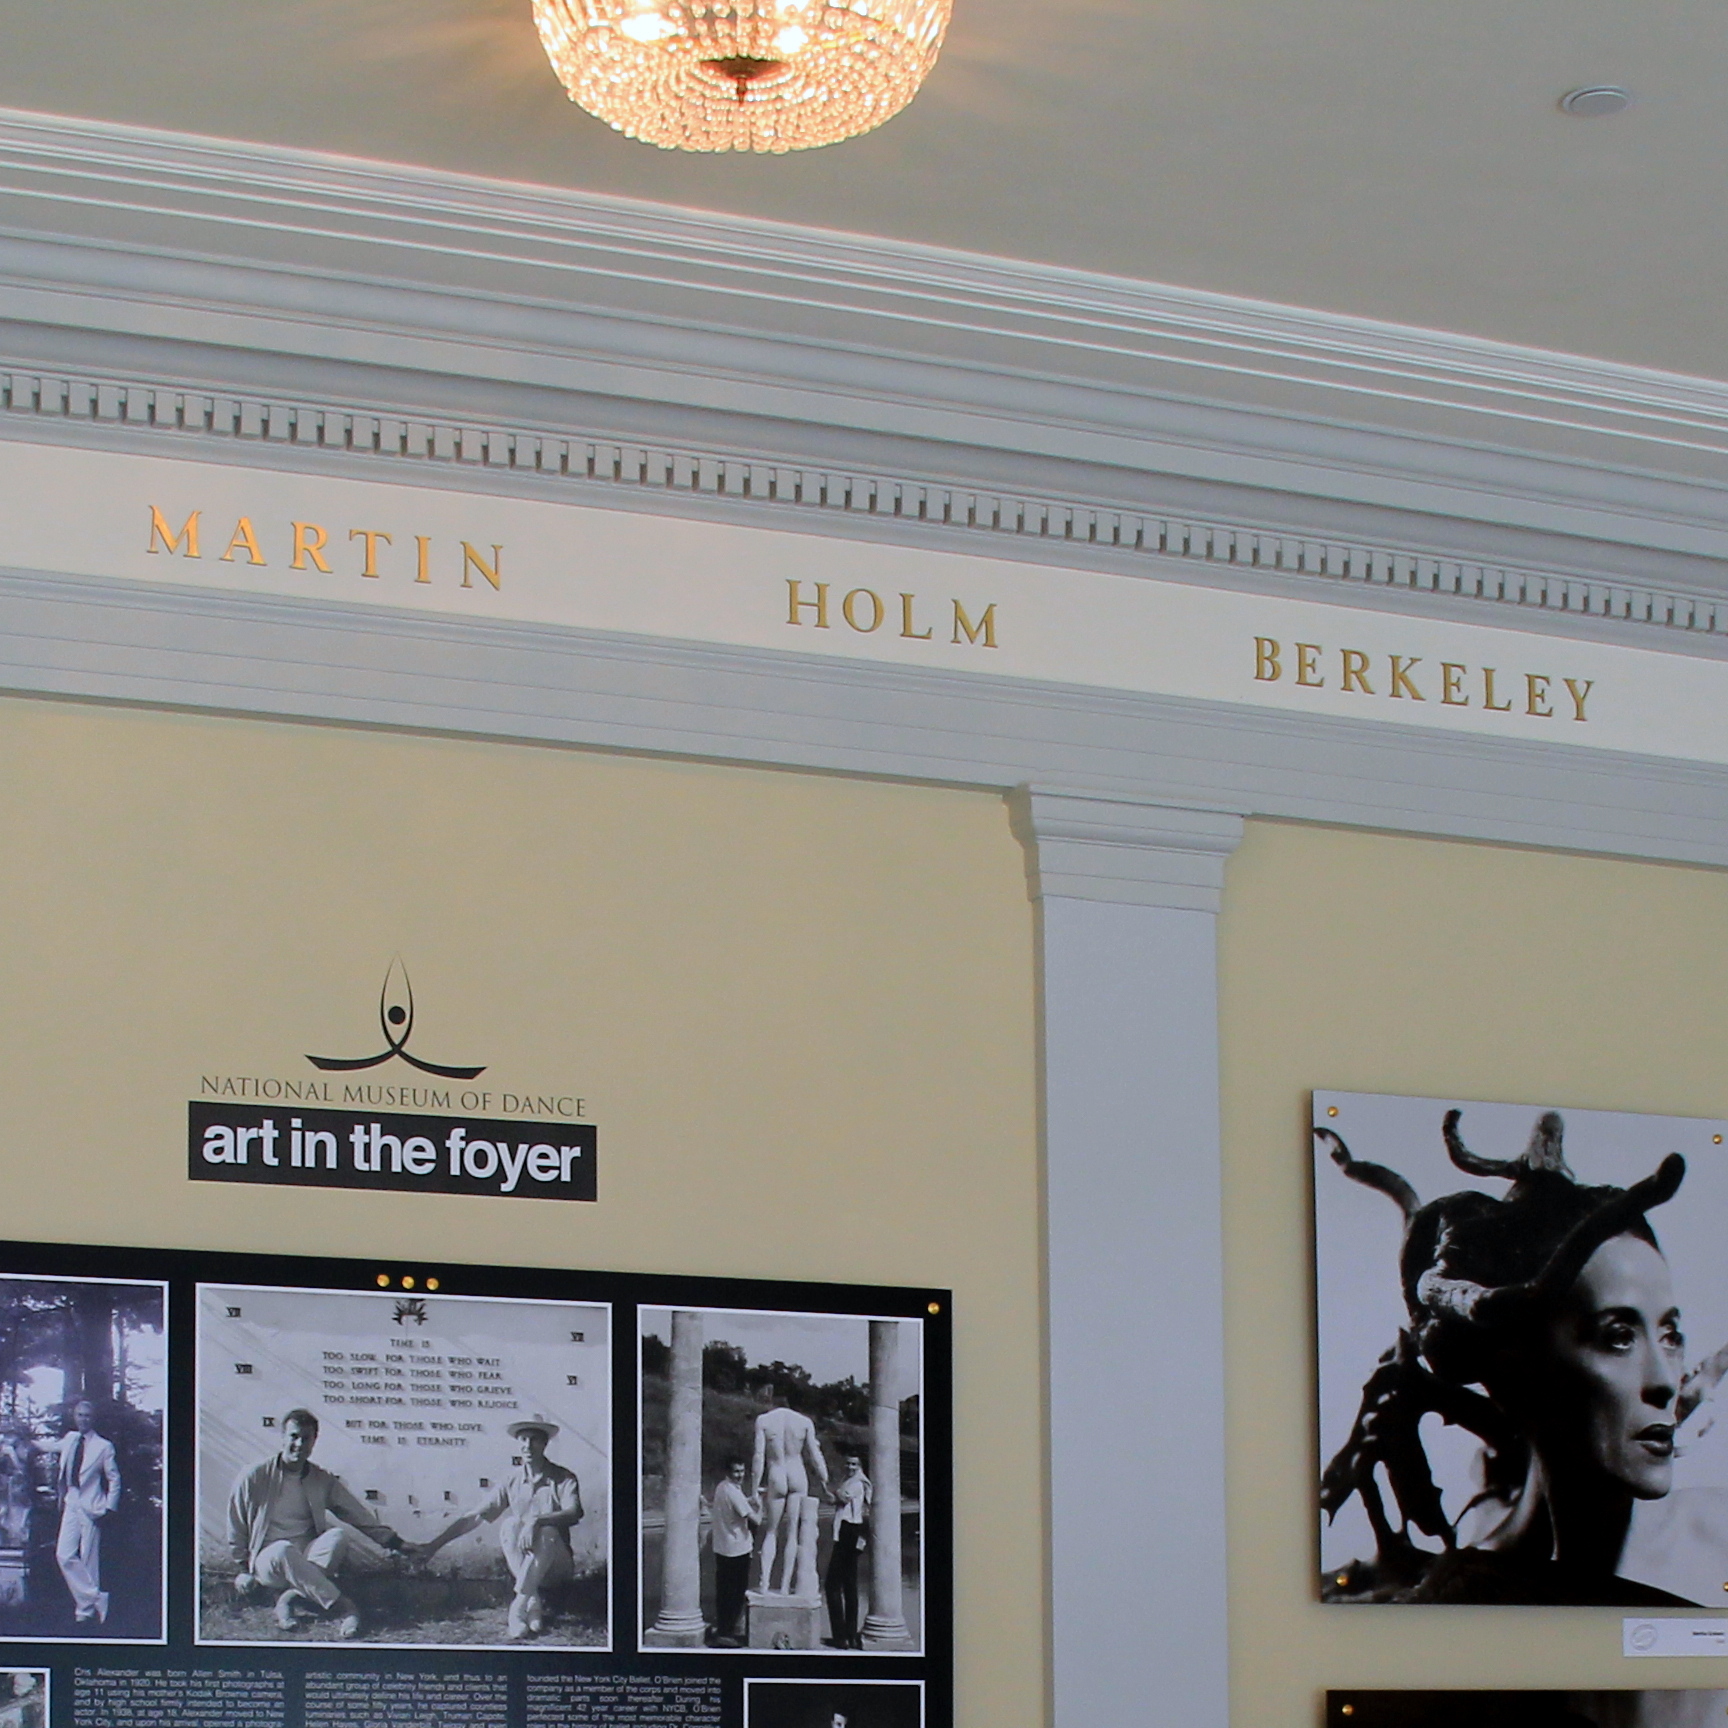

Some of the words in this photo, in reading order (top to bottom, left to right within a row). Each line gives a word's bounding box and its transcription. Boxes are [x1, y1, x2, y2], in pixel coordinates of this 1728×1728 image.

[147, 504, 505, 591] MARTIN
[786, 578, 1001, 650] HOLM
[1253, 635, 1597, 724] BERKELEY
[201, 1075, 334, 1100] NATIONAL
[343, 1084, 452, 1108] MUSEUM
[460, 1091, 492, 1111] OF
[502, 1094, 586, 1116] DANCE
[202, 1117, 279, 1165] art
[290, 1118, 337, 1168] in
[349, 1122, 436, 1174] the
[445, 1128, 581, 1193] foyer
[390, 1339, 414, 1347] TIME
[322, 1351, 345, 1360] TOO
[350, 1353, 377, 1361] SLOW
[385, 1354, 405, 1362] FOR
[409, 1355, 443, 1363] THOSE
[447, 1357, 472, 1365] WHO
[476, 1358, 500, 1366] WAIT
[322, 1366, 345, 1374] TOO
[350, 1367, 378, 1375] SWIFT
[384, 1367, 404, 1376] FOR
[410, 1369, 441, 1377] THOSE
[478, 1371, 502, 1379] FEAR
[322, 1380, 345, 1389] TOO
[351, 1381, 381, 1390] LONG
[384, 1382, 405, 1390] FOR
[409, 1383, 444, 1392] THOSE
[448, 1385, 473, 1393] WHO
[477, 1386, 513, 1394] GRIEVE
[322, 1394, 345, 1403] TOO
[348, 1395, 383, 1404] SHORT
[410, 1398, 442, 1406] THOSE
[448, 1399, 472, 1407] WHO
[477, 1400, 518, 1408] REJOICE
[368, 1420, 389, 1428] FOR
[392, 1421, 425, 1429] THOSE
[429, 1422, 455, 1430] WHO
[457, 1423, 484, 1431] LOVE
[360, 1435, 387, 1444] TIME
[416, 1437, 467, 1445] ETERNITY
